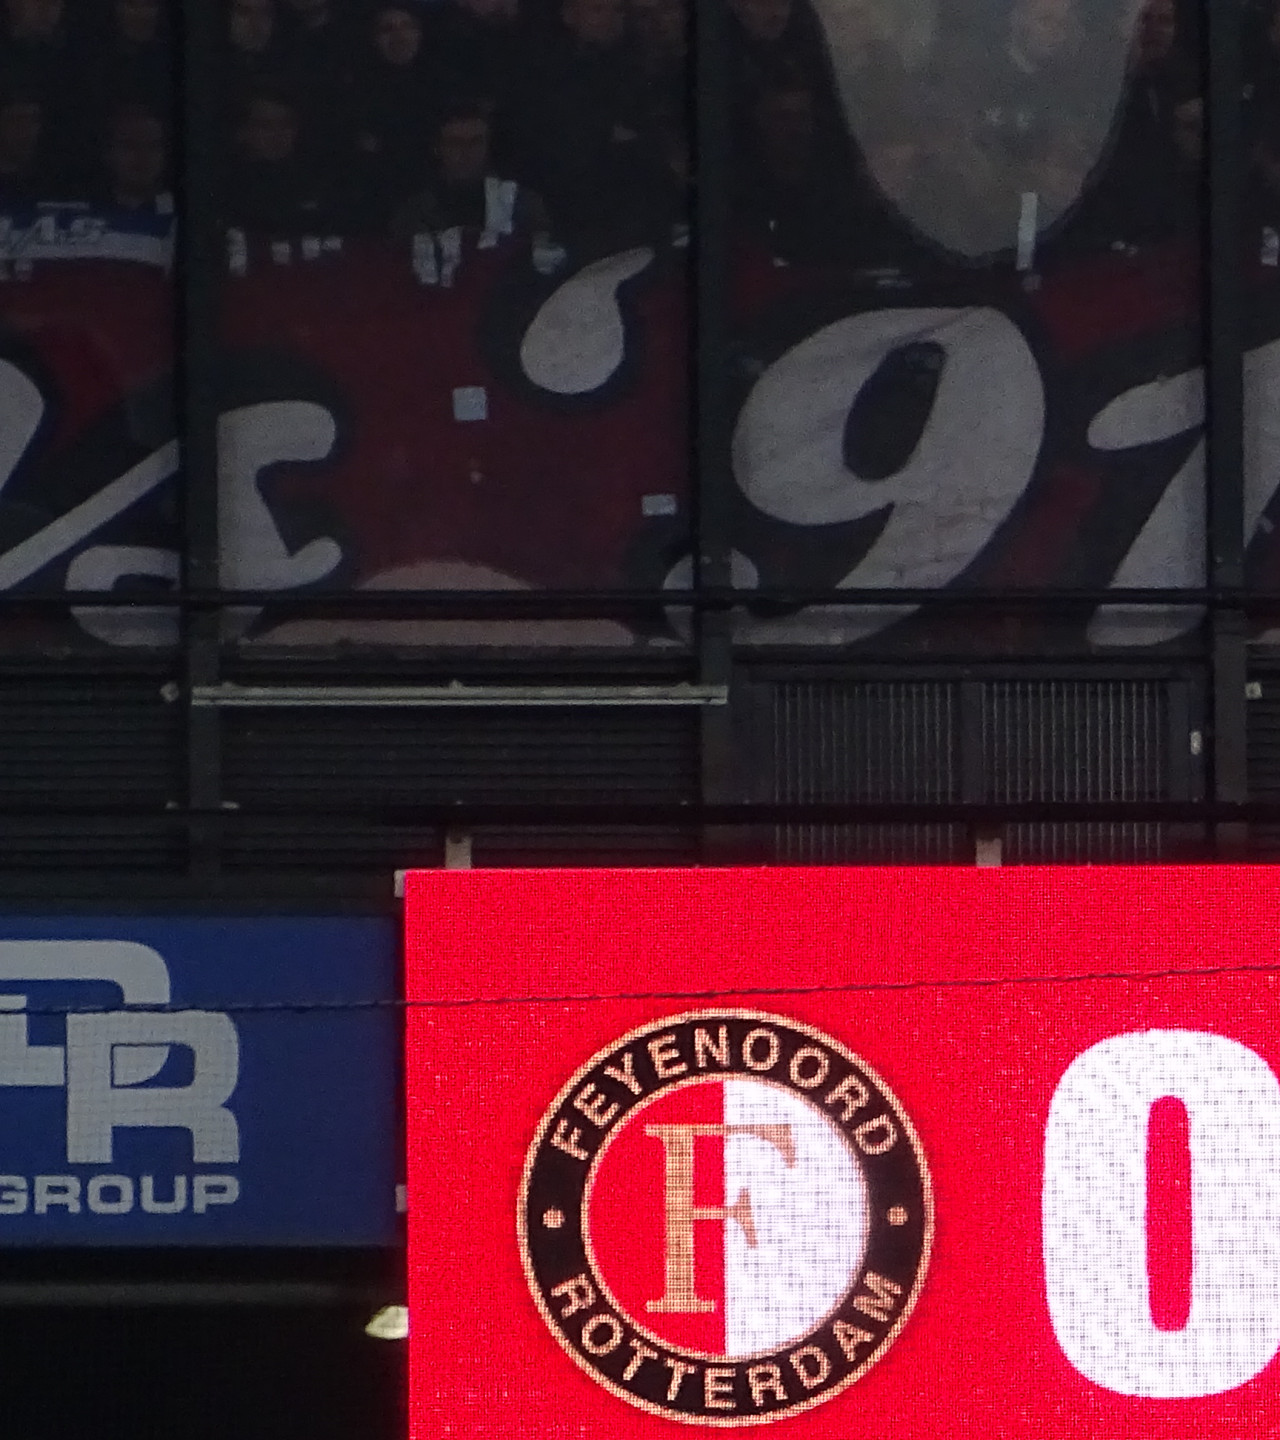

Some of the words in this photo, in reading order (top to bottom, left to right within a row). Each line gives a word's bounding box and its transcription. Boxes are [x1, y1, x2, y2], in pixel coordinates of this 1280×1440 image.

[551, 1024, 899, 1162] FEYENOORD
[0, 1175, 240, 1214] GROUP
[644, 1122, 797, 1314] F
[551, 1272, 902, 1409] ROTTERDAM
